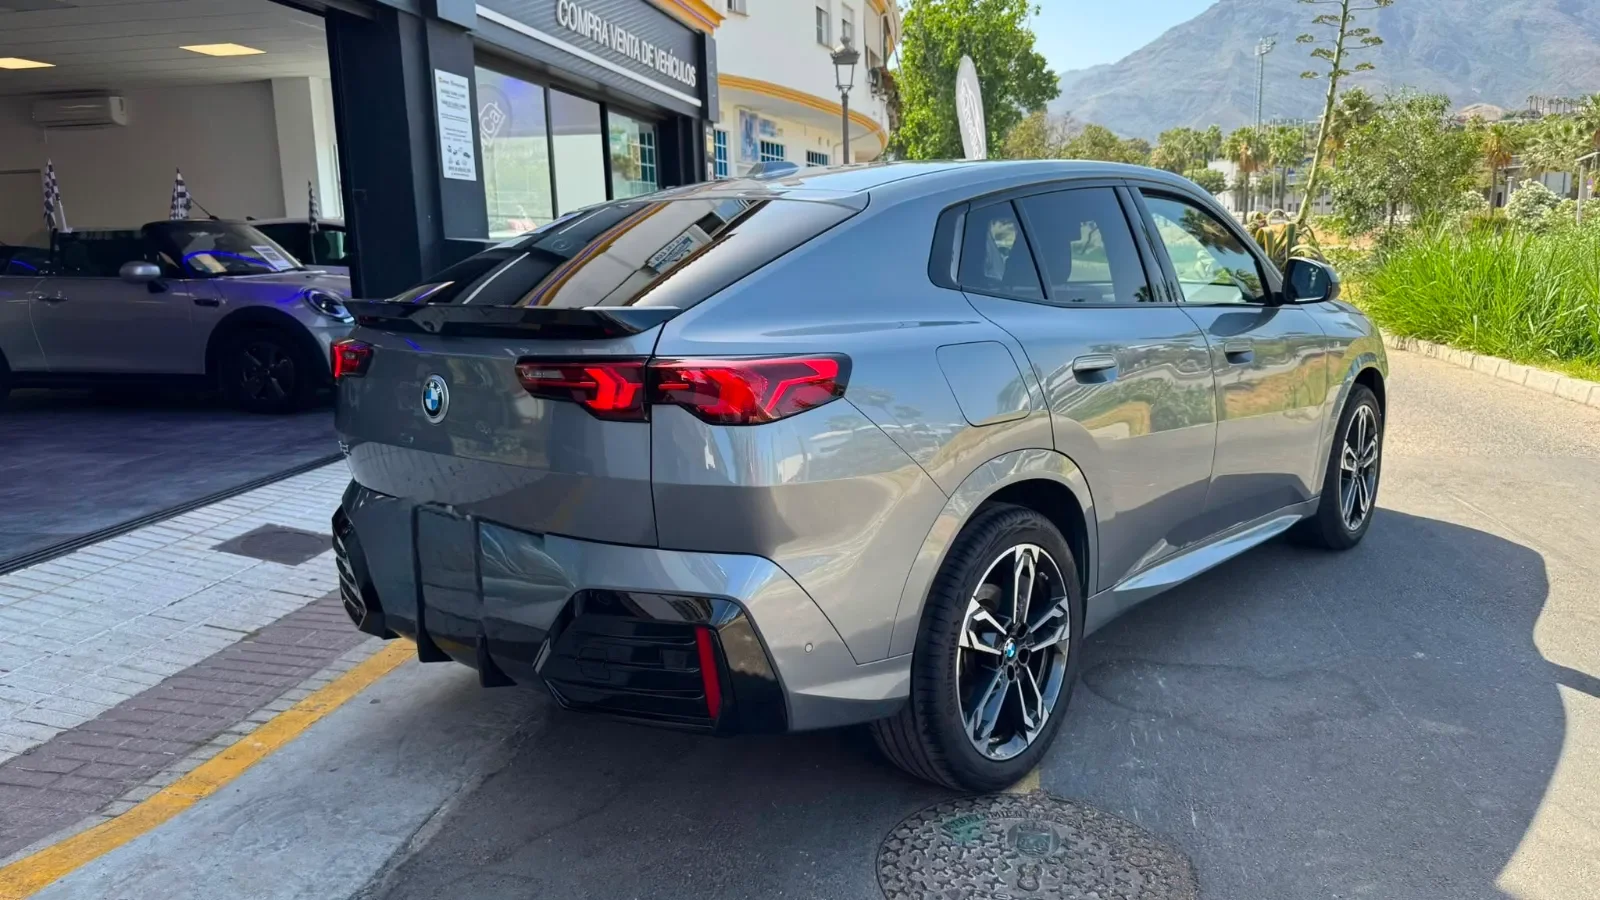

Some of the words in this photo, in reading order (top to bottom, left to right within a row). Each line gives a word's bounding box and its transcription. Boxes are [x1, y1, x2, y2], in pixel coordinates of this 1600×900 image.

[557, 0, 609, 47] COMPRA
[610, 23, 641, 61] VENTA
[641, 40, 654, 67] DE
[654, 47, 696, 87] VEHÍCULOS
